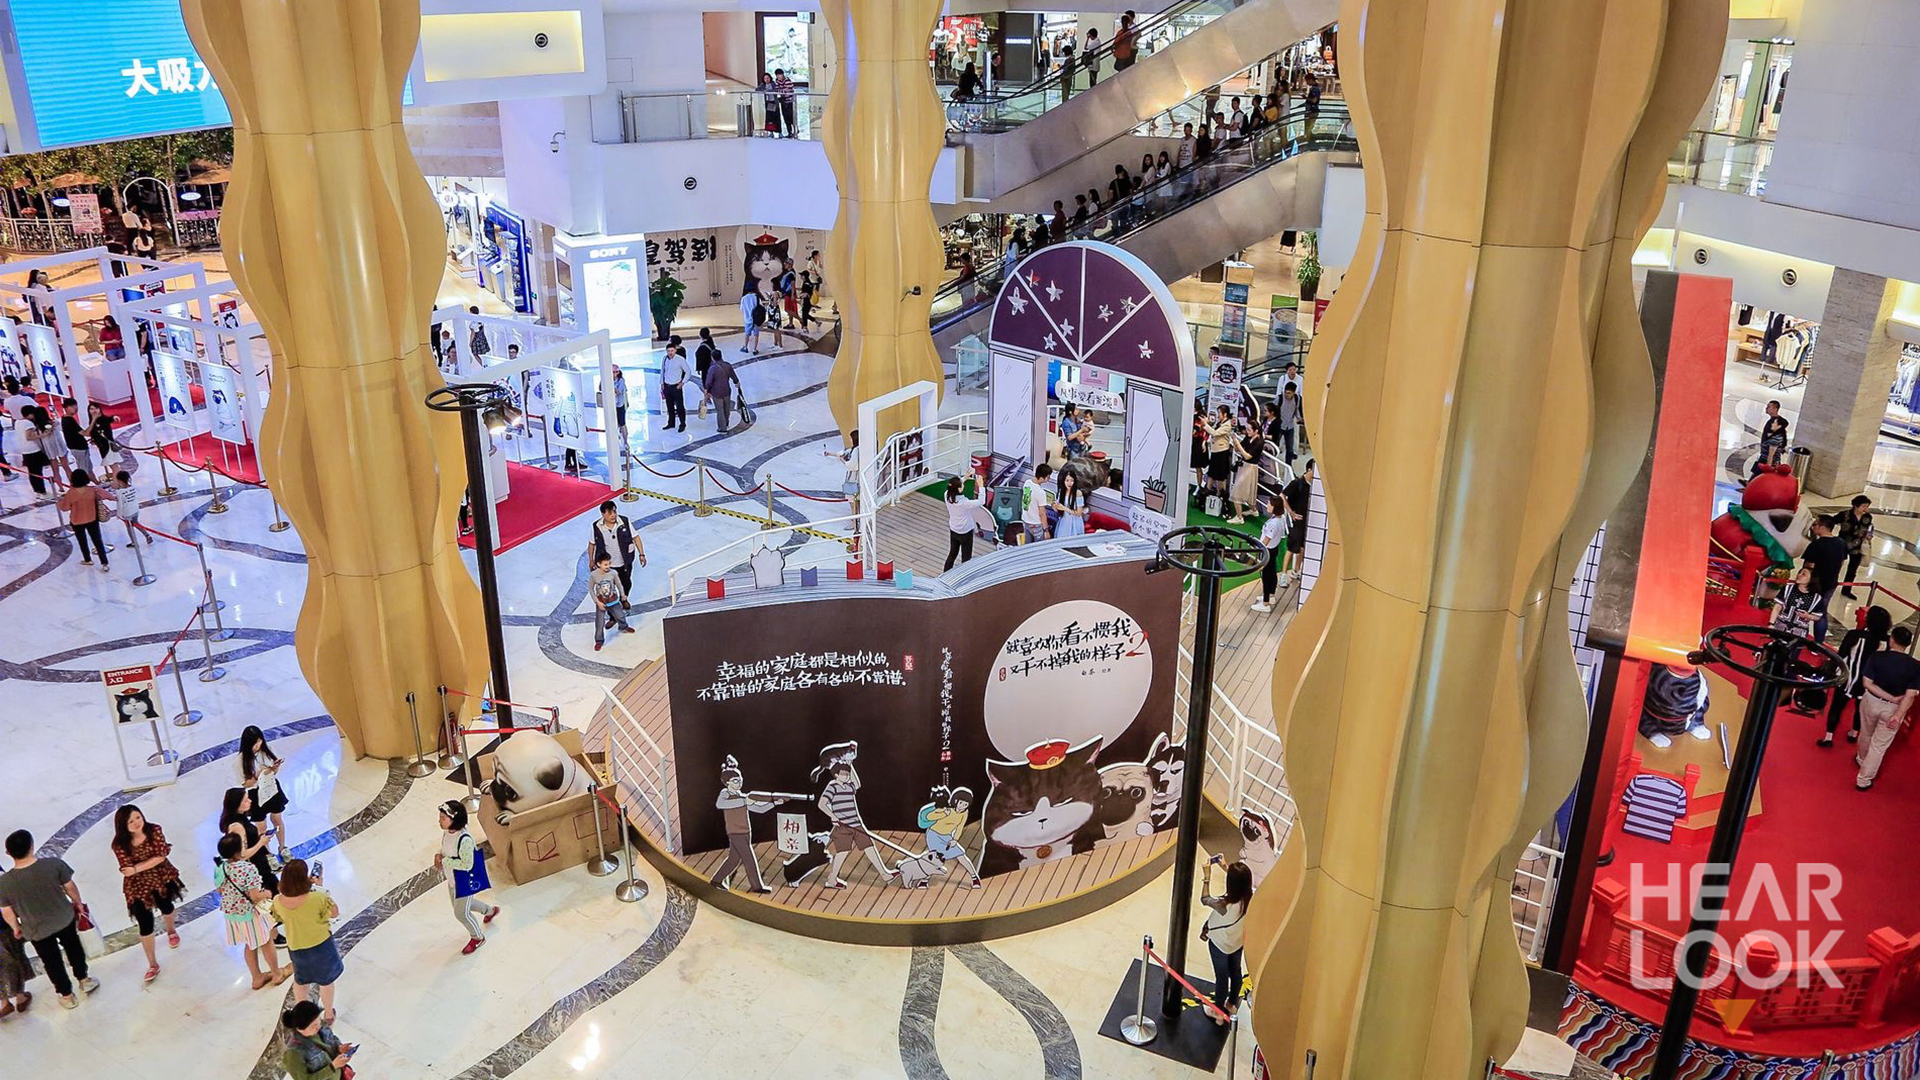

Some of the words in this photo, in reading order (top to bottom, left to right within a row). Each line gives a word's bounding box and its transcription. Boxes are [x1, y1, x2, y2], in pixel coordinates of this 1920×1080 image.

[589, 246, 628, 259] SONY
[1006, 617, 1131, 657] 就喜欢你看不惯我
[1009, 642, 1126, 677] 又干不掉我的样子
[1125, 630, 1148, 658] 2
[107, 668, 144, 678] ENTRANCE
[109, 676, 124, 685] 入口
